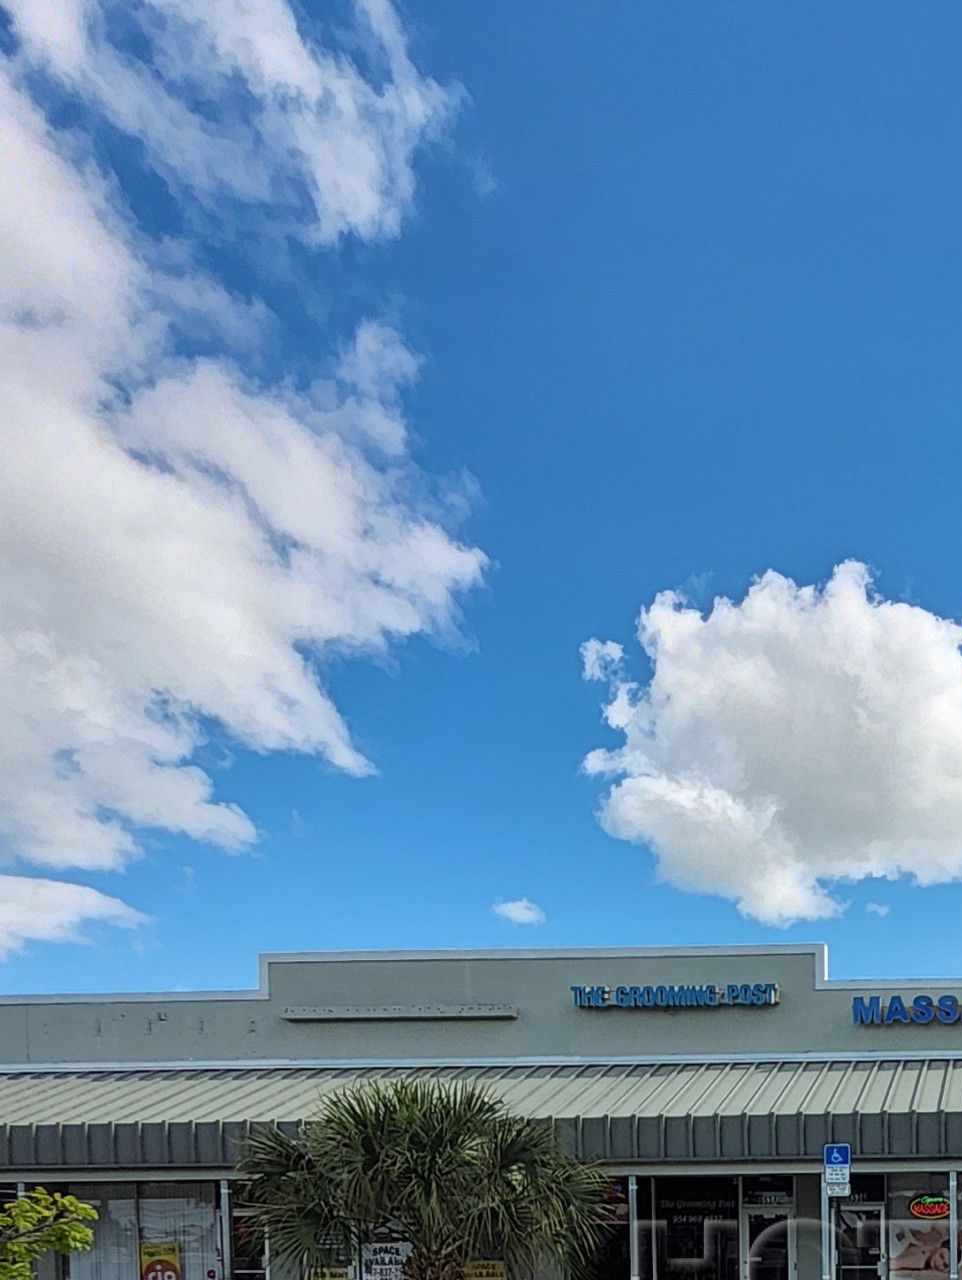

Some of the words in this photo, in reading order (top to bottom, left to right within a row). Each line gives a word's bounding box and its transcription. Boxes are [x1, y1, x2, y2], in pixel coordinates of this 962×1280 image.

[571, 986, 610, 1007] THE
[615, 985, 718, 1007] GROOMING
[726, 984, 778, 1005] POST
[913, 1203, 950, 1214] MASSAGE
[372, 1245, 401, 1256] SPACE
